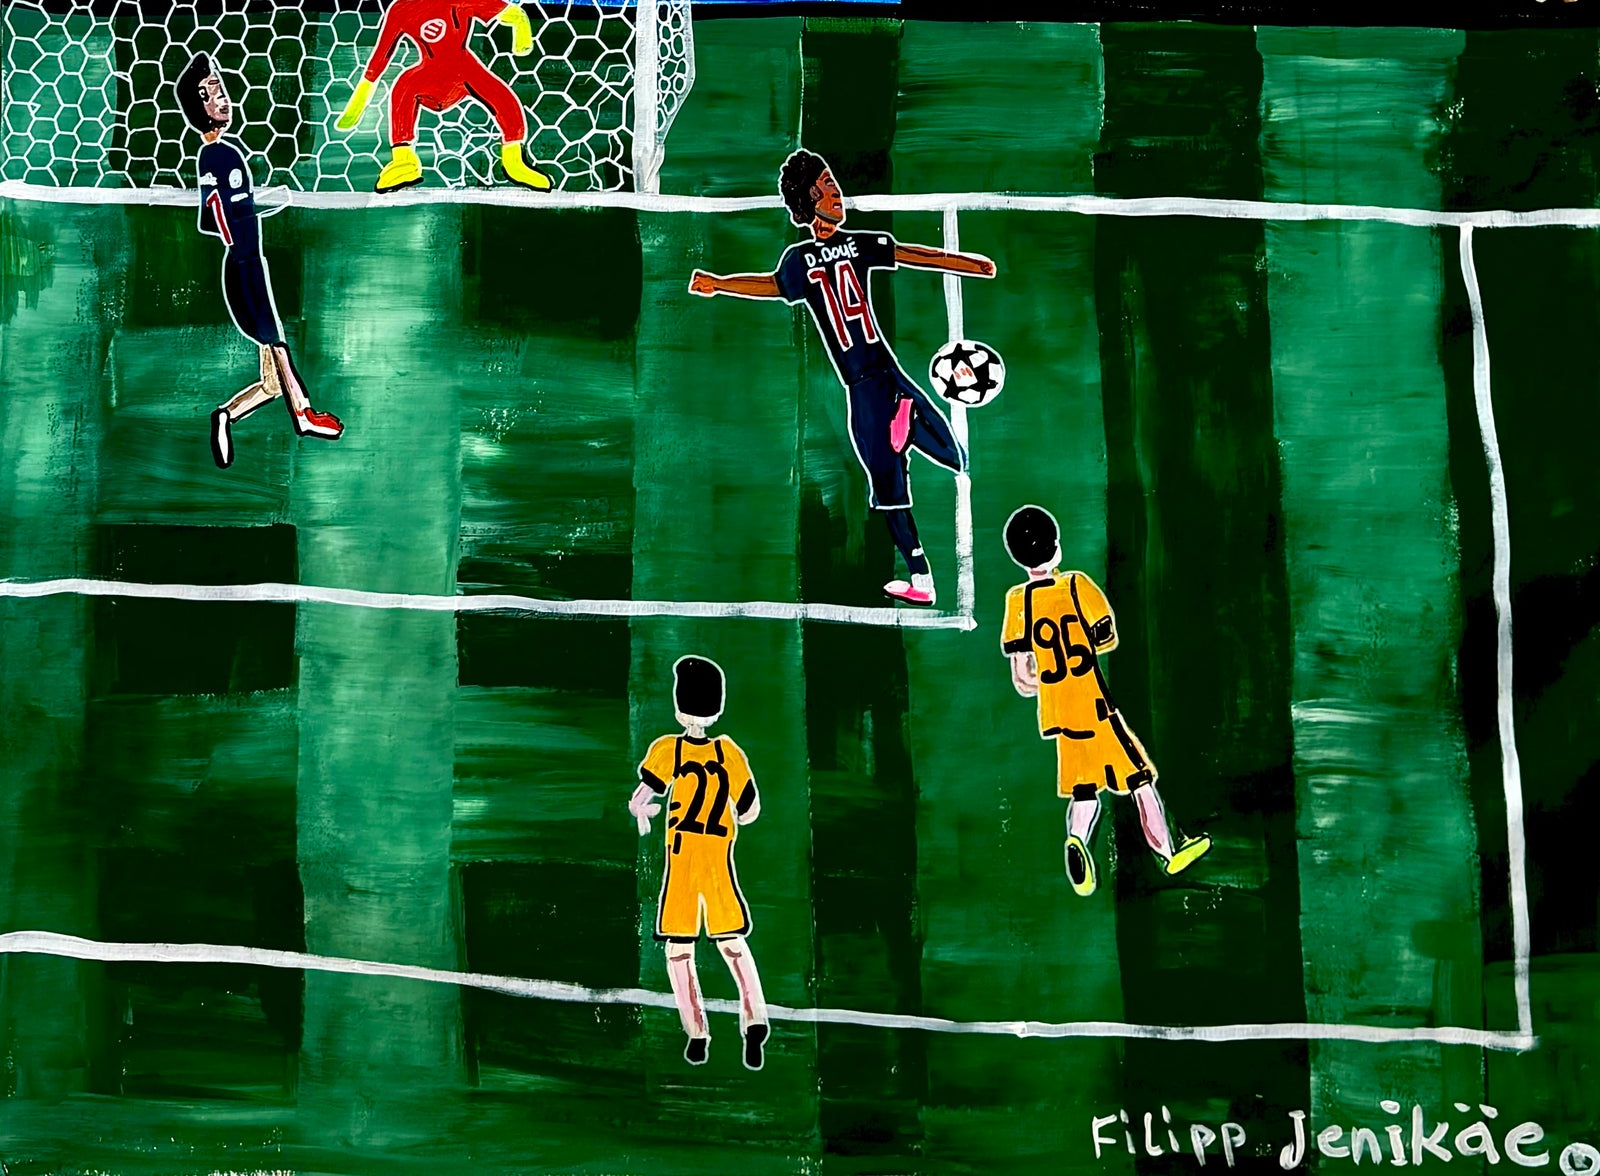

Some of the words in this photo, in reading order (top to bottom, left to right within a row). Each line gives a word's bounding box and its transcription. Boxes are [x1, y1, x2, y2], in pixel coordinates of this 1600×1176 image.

[806, 260, 880, 352] 14
[1033, 614, 1095, 685] 95
[675, 760, 730, 838] 22
[1091, 1105, 1246, 1167] Filipp
